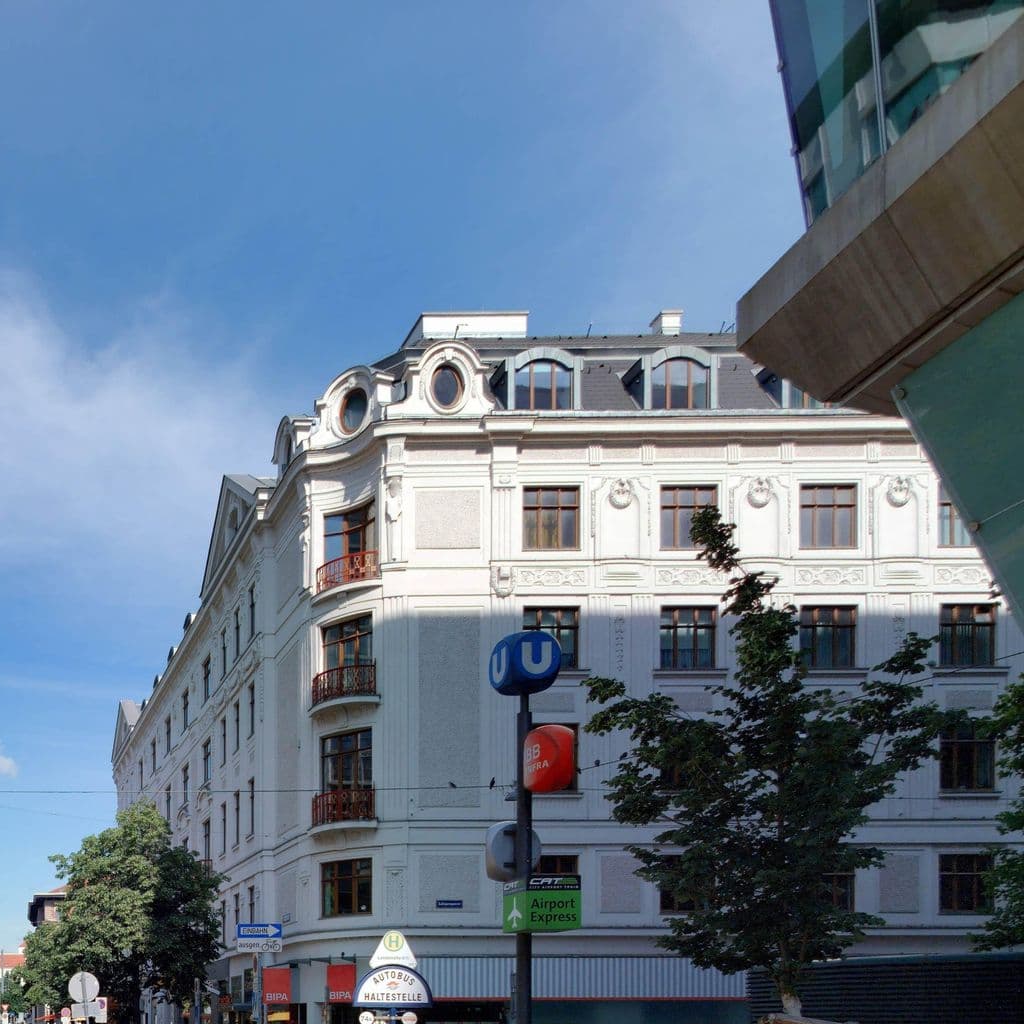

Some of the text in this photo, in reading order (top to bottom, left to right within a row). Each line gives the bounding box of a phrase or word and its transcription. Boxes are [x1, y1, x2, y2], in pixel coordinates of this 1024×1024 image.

[521, 641, 552, 674] U
[492, 646, 506, 684] U
[529, 877, 563, 885] CAT
[531, 898, 576, 911] Airport
[531, 911, 576, 925] Express
[242, 927, 268, 935] EINBAHN
[388, 935, 399, 948] H
[373, 970, 416, 986] AUTOBUS
[266, 992, 288, 1001] BIPA
[329, 991, 352, 1000] BIPA
[364, 992, 422, 1002] HALTESTELLE
